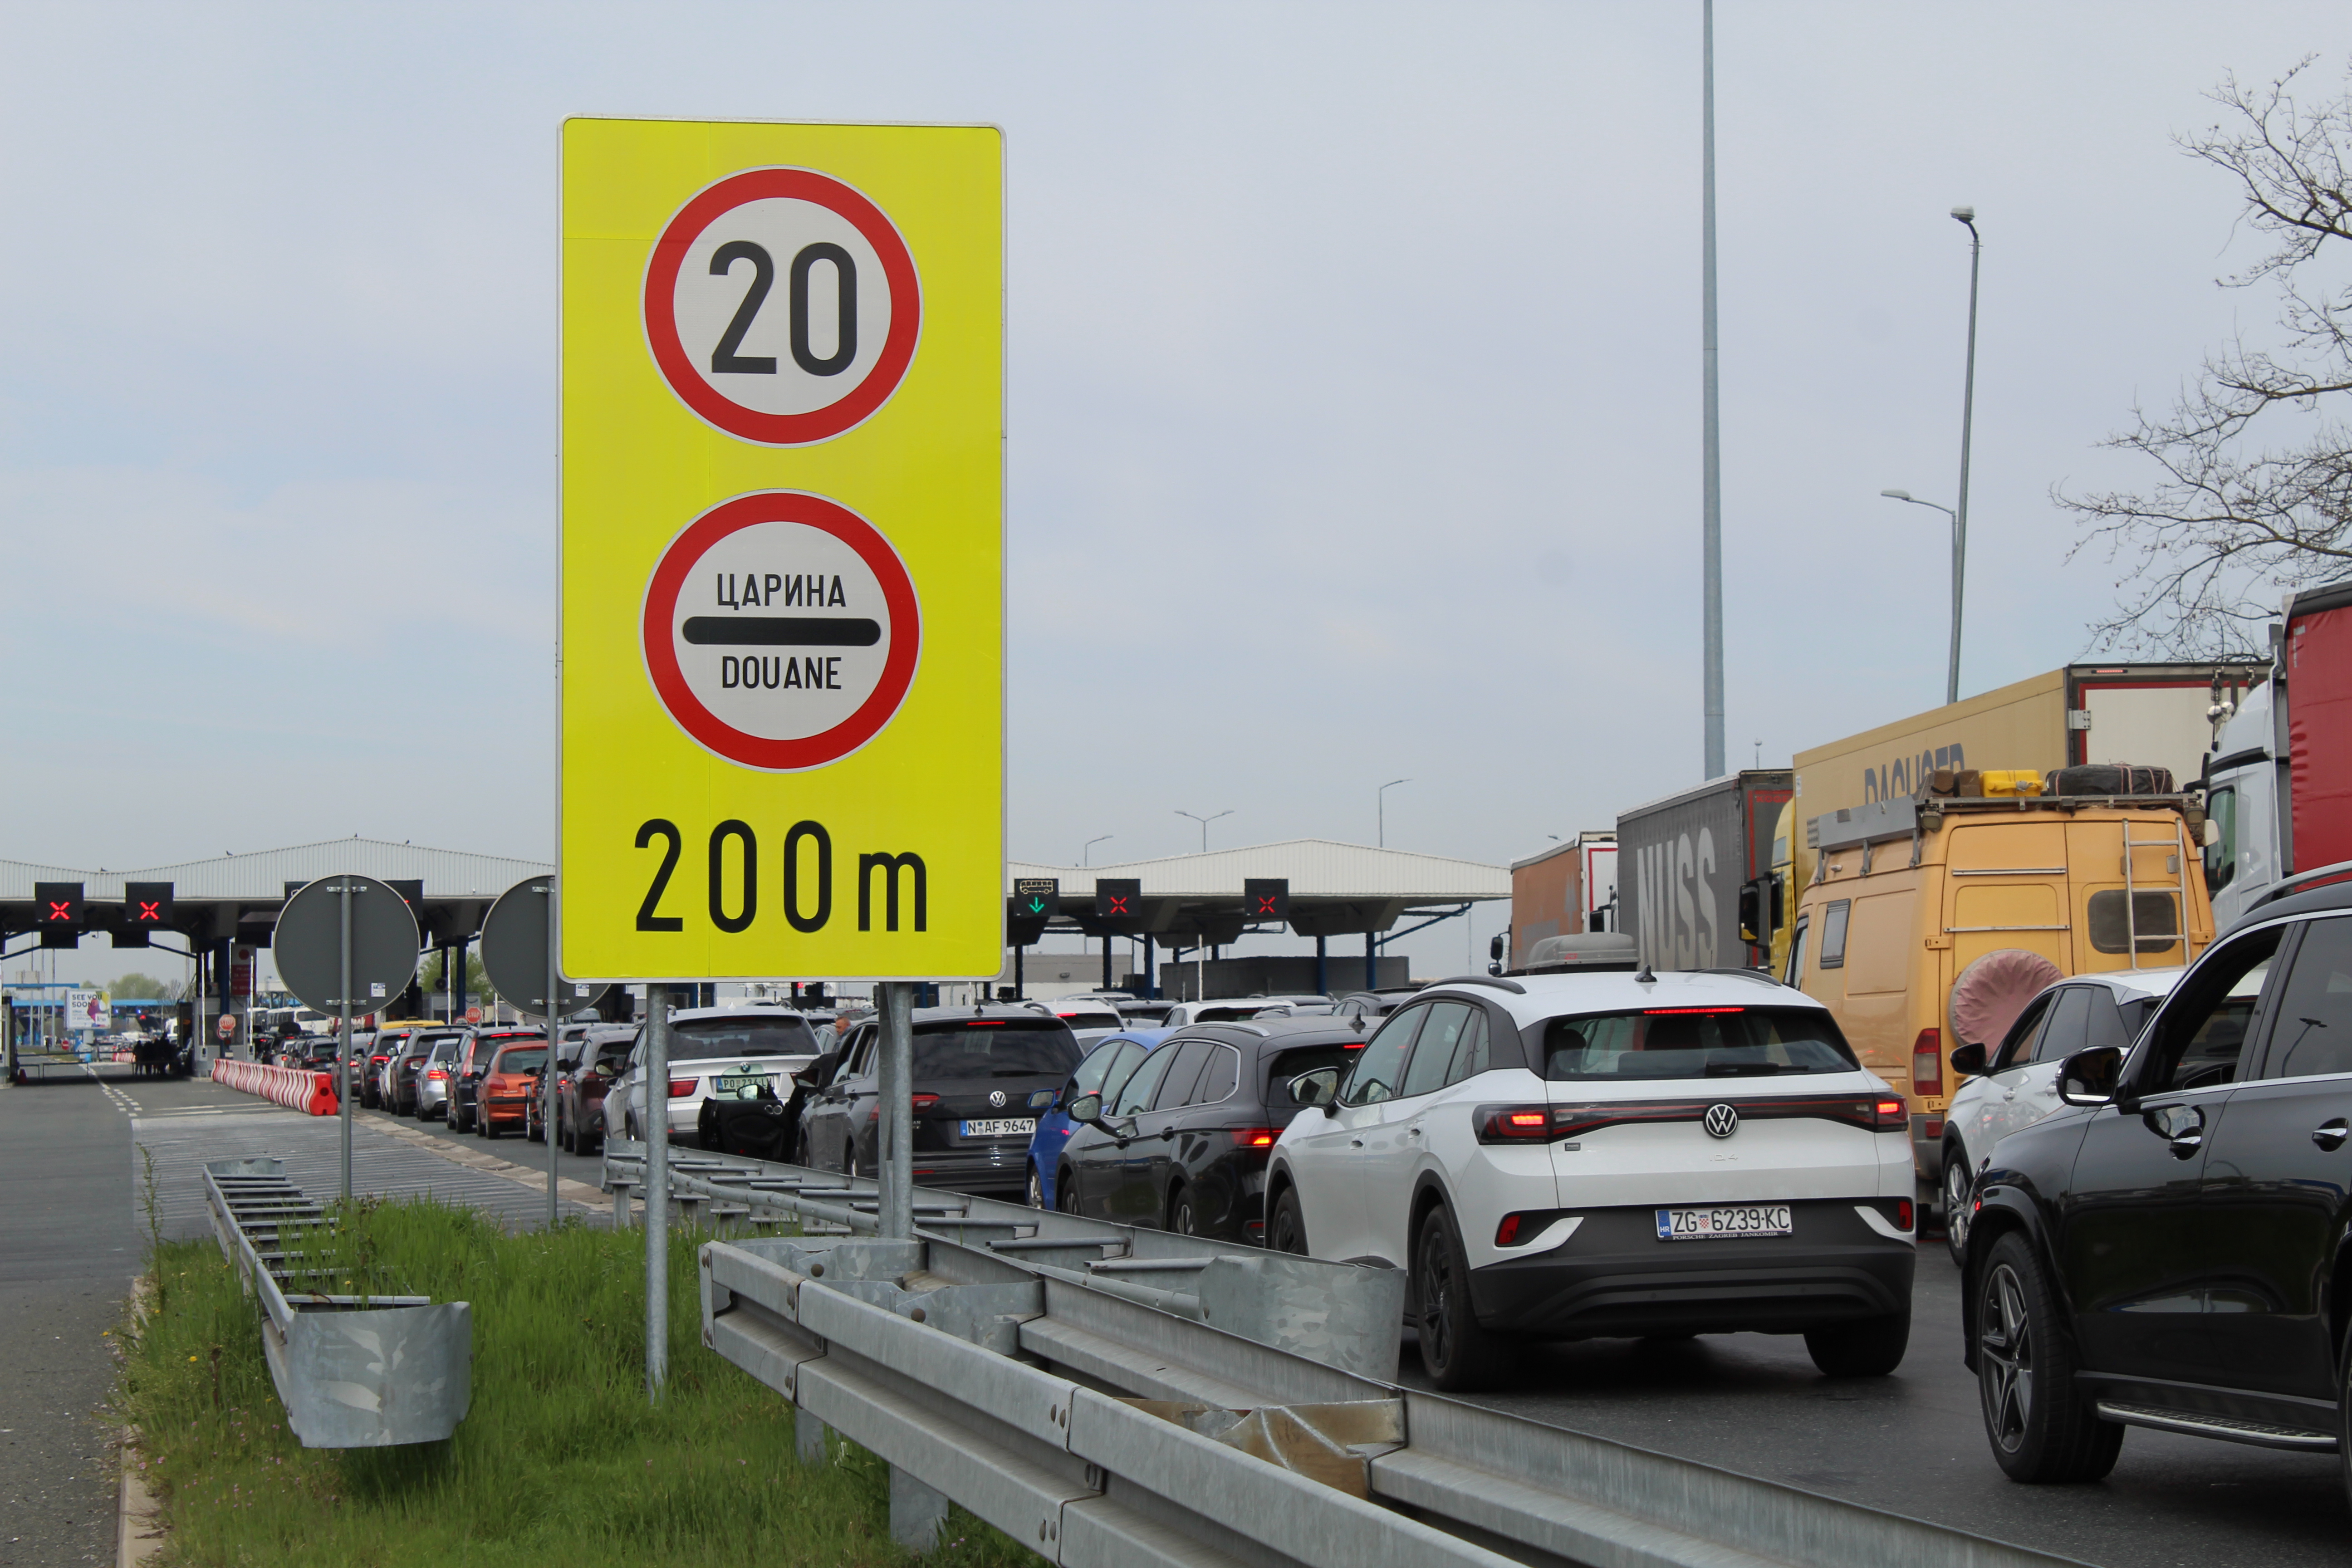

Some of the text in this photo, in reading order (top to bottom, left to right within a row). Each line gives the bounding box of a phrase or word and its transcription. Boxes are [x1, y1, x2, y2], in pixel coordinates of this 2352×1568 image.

[709, 240, 857, 377] 20
[717, 573, 847, 611] ЦАРИНА
[721, 656, 842, 690] DOUANE
[1637, 827, 1718, 972] NUSS
[724, 1079, 735, 1088] PO
[968, 1122, 976, 1134] N
[985, 1121, 1000, 1133] AF
[1004, 1120, 1034, 1132] 9647
[1672, 1211, 1697, 1233] ZG
